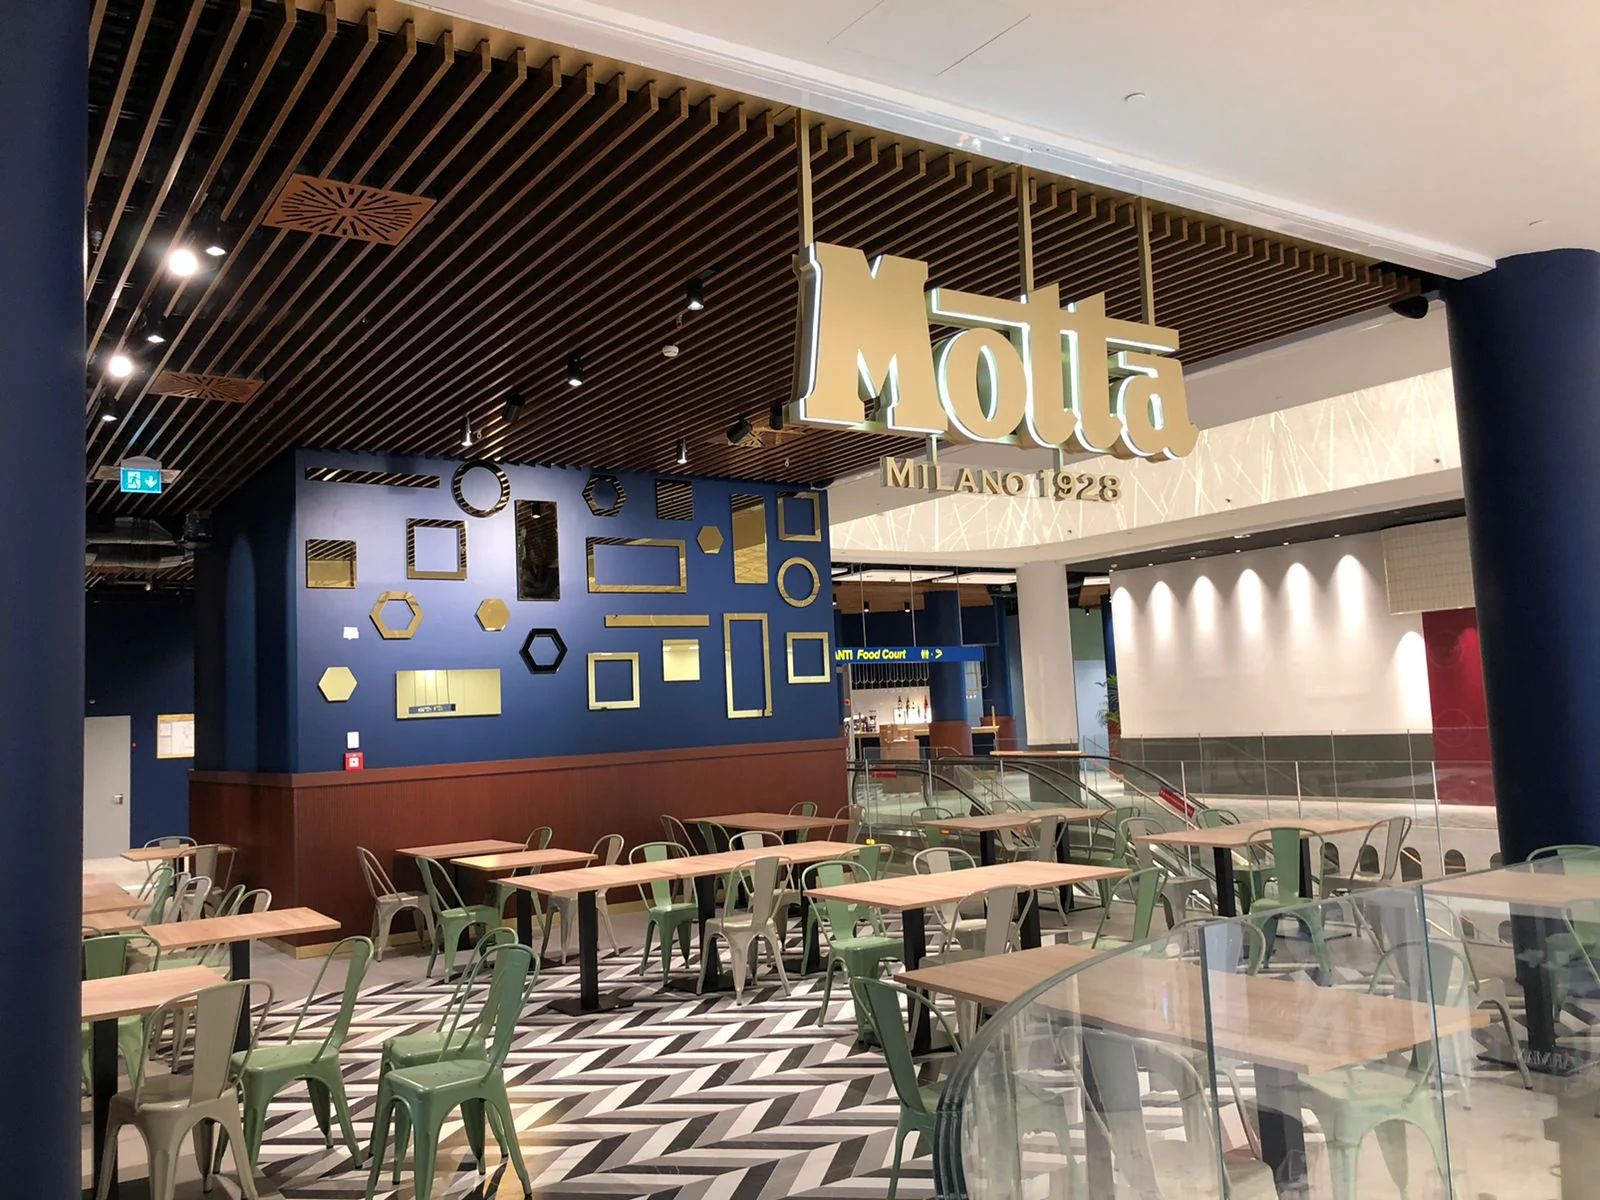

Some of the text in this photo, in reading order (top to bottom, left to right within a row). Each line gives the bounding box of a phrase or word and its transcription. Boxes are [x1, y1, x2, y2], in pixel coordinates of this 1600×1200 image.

[796, 240, 1200, 462] Motta
[881, 456, 1122, 502] MILANO 1928
[857, 649, 880, 660] Food
[882, 649, 907, 660] Court
